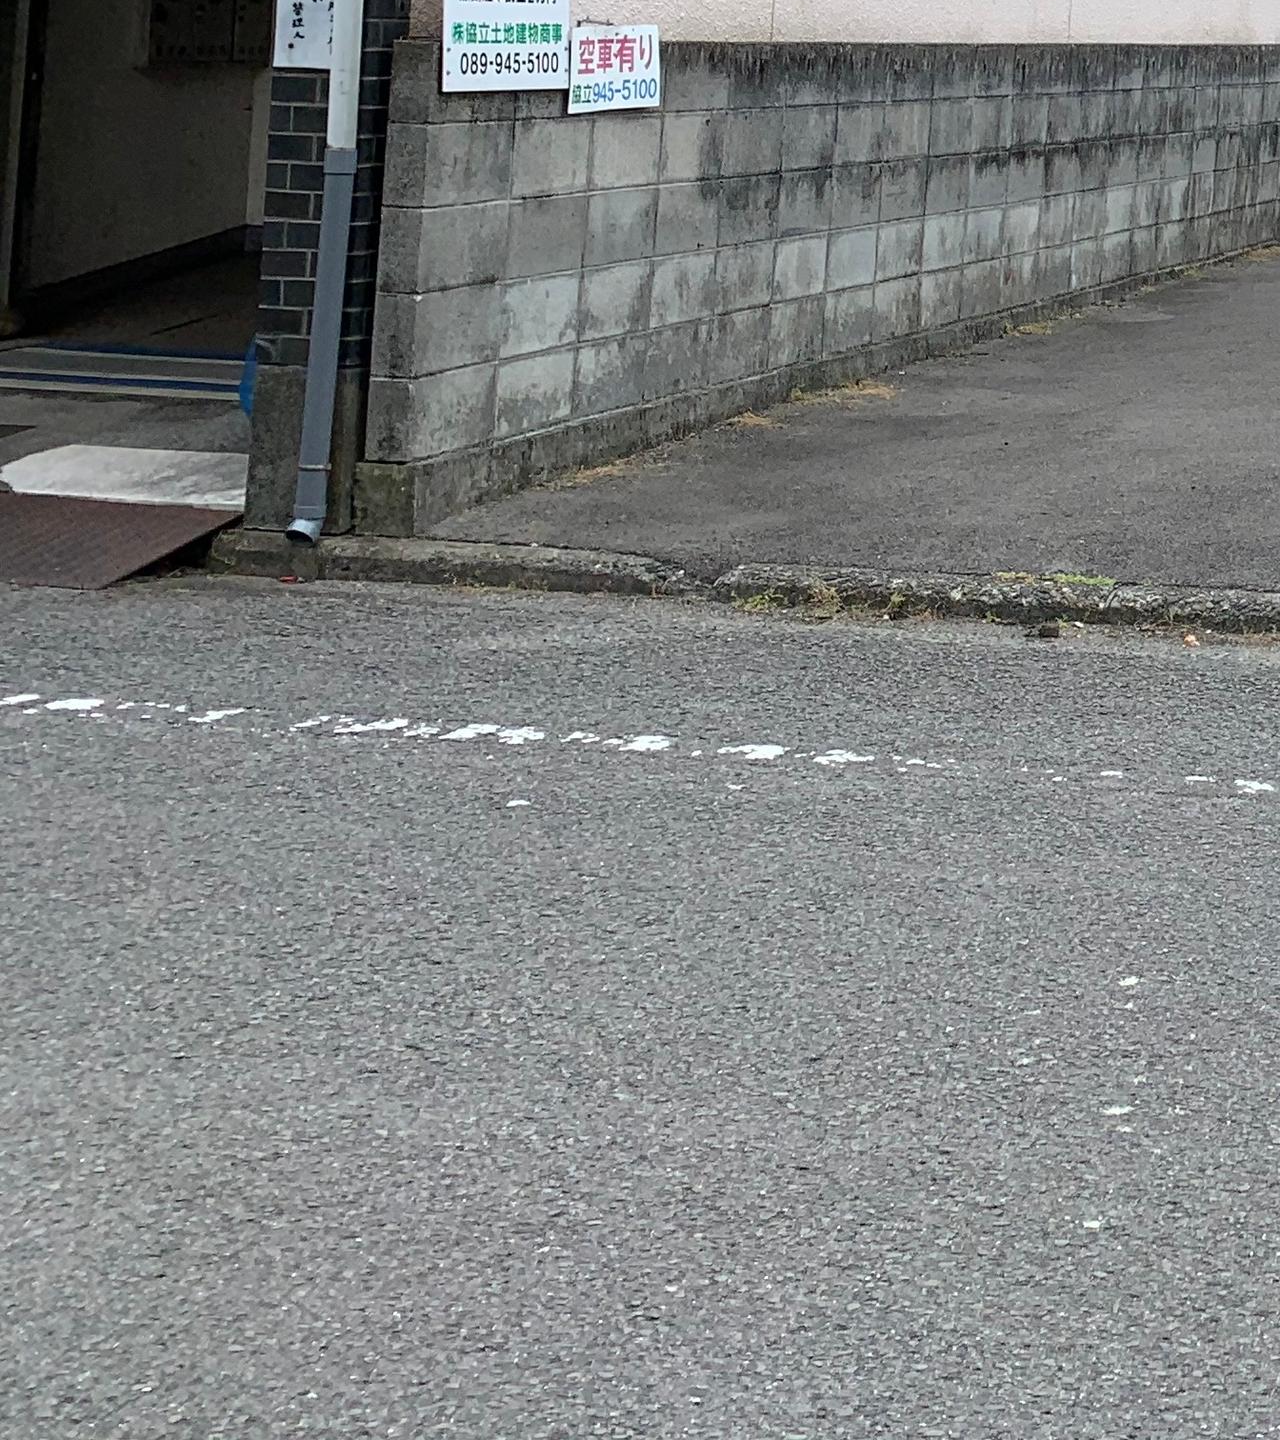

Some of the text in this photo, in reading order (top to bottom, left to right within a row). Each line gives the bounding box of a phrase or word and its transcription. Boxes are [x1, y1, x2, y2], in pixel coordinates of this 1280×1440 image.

[460, 51, 559, 75] 089-945-5100
[577, 34, 653, 75] 空車有り
